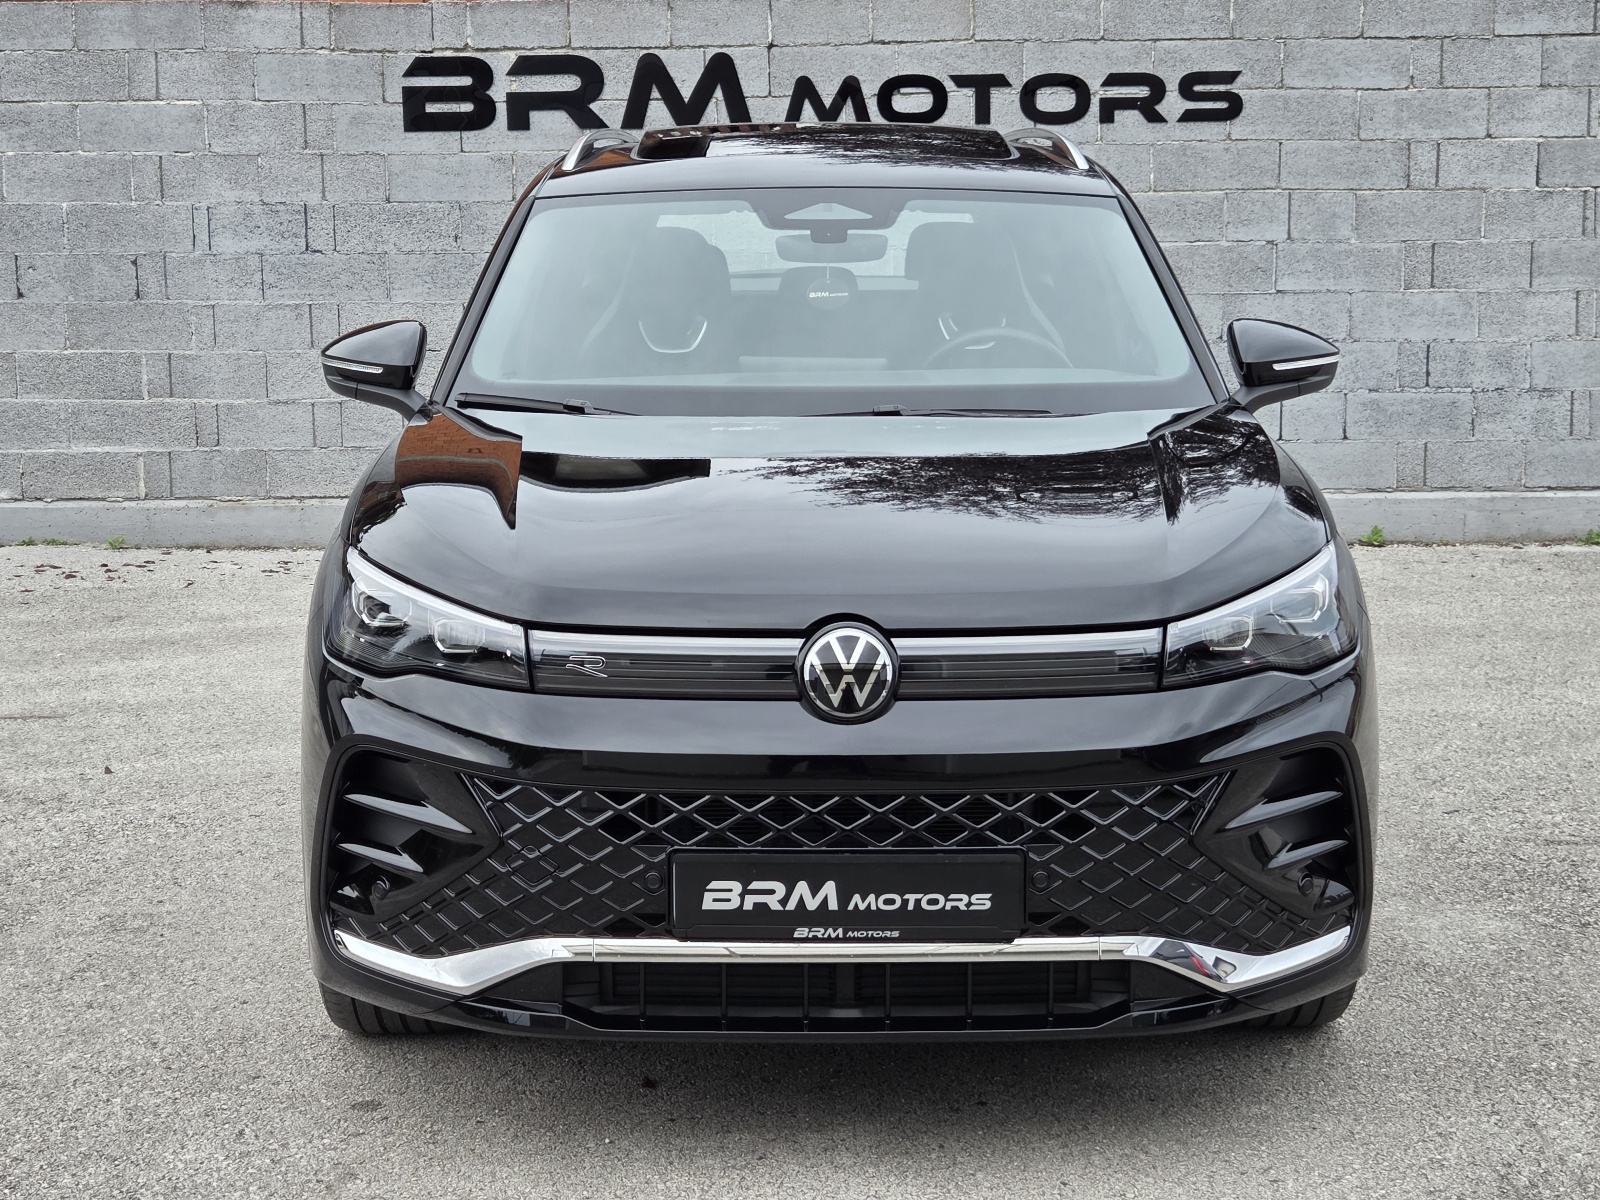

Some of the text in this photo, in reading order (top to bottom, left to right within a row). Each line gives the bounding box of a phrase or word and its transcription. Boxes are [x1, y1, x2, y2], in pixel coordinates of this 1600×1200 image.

[402, 52, 1245, 132] BRM MOTORS
[702, 880, 993, 911] BRM MOTORS
[793, 927, 900, 938] BRM MOTORS
